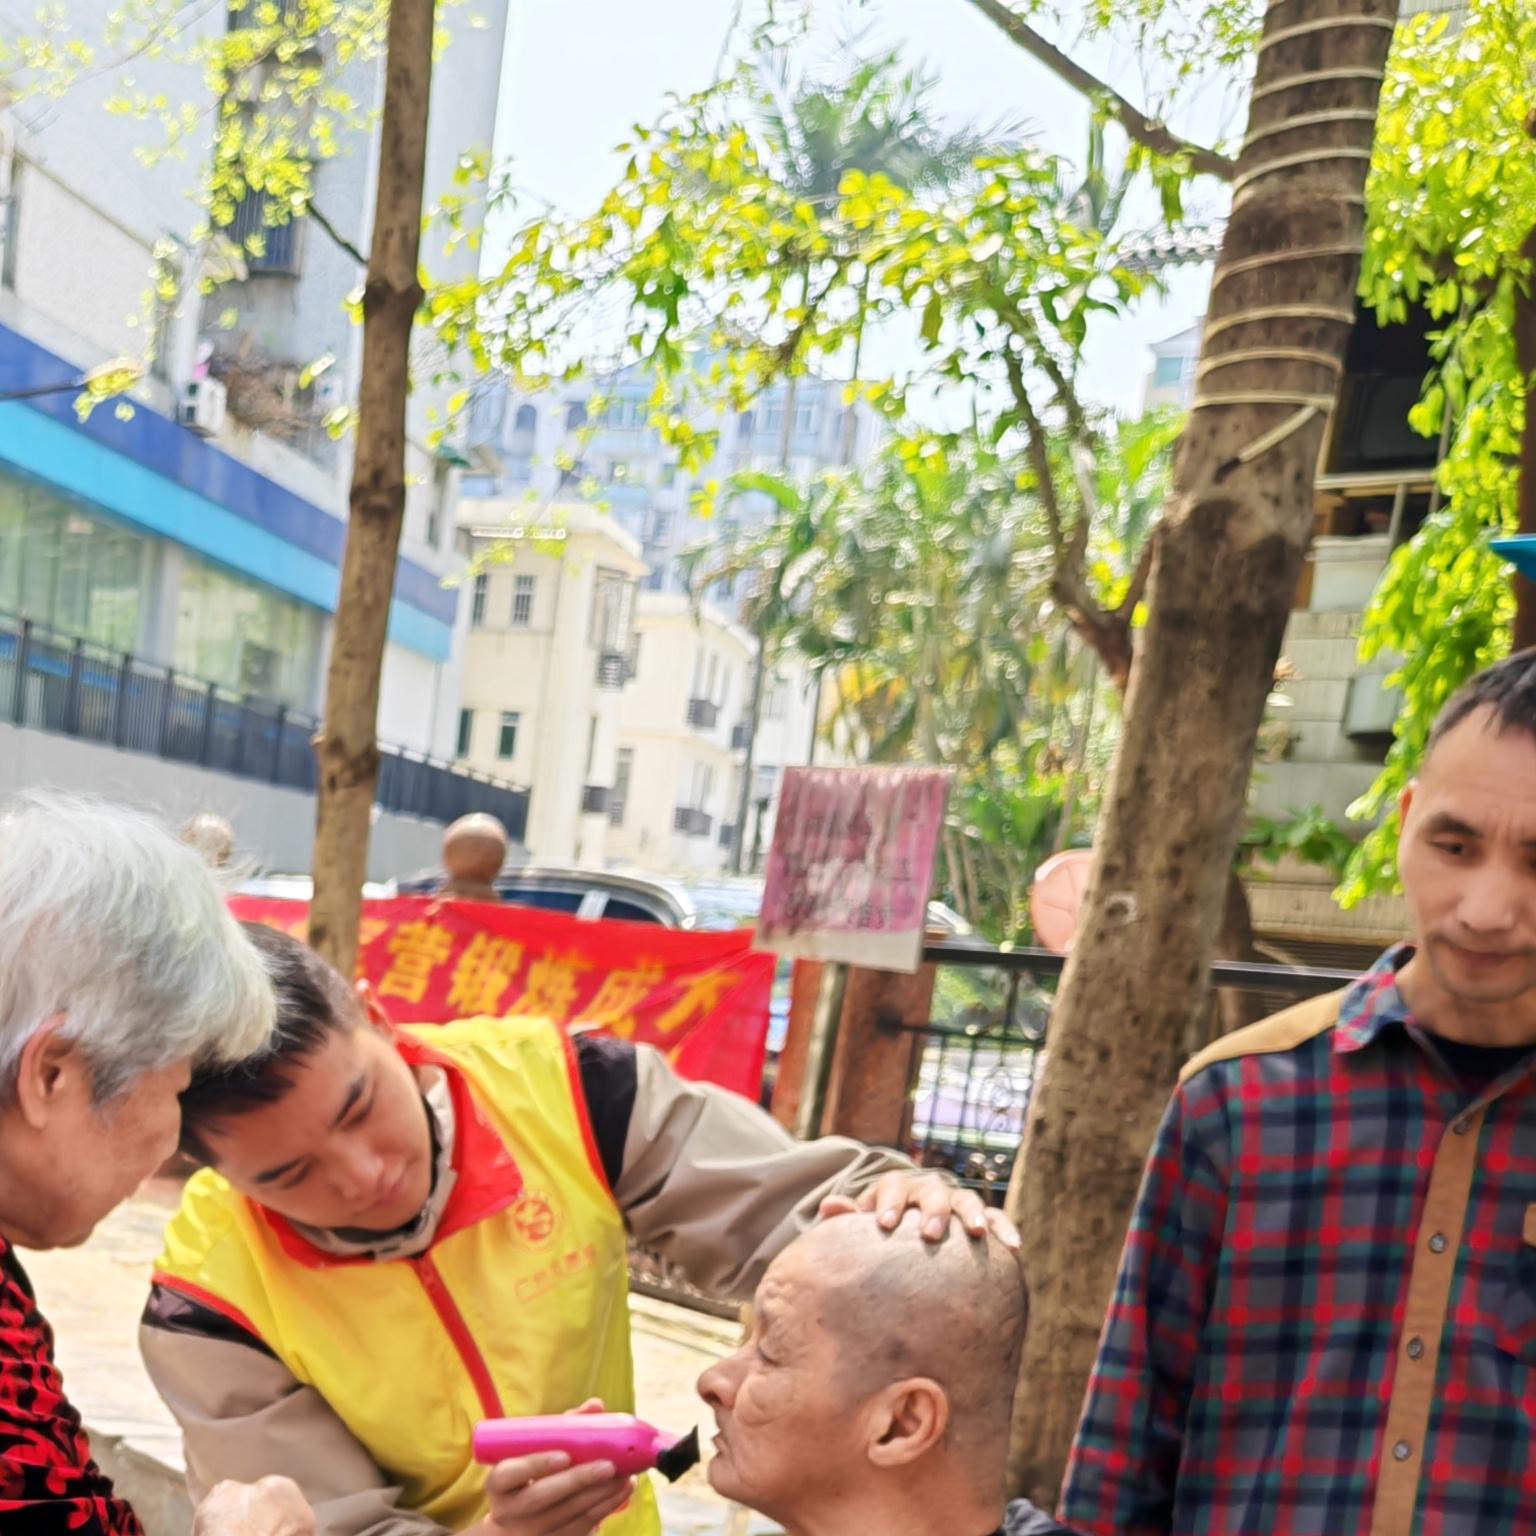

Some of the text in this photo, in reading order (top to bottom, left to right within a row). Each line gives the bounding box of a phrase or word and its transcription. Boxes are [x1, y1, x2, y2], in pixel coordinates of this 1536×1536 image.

[358, 917, 742, 1040] 营锻炼成才
